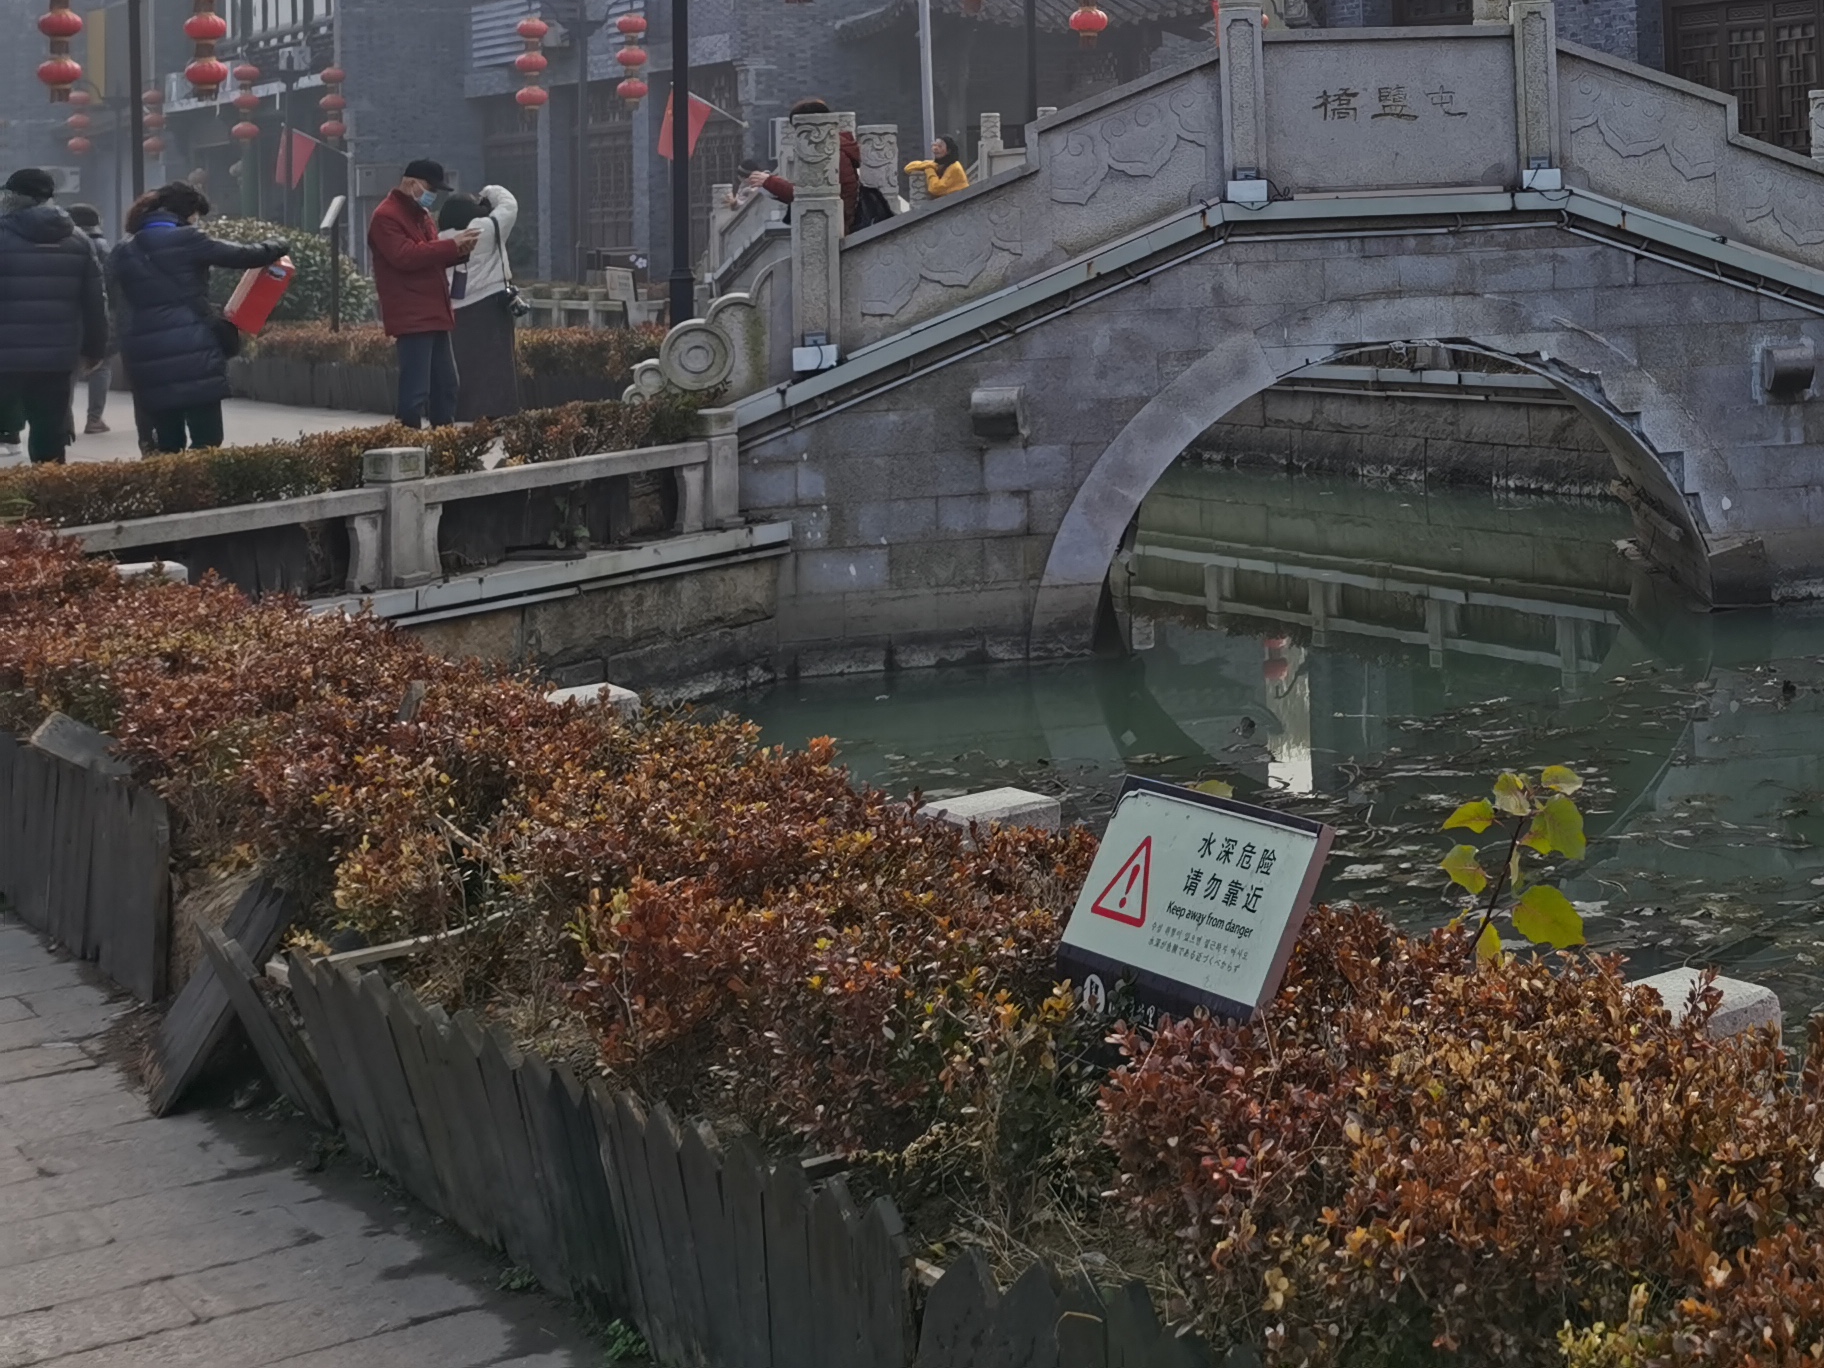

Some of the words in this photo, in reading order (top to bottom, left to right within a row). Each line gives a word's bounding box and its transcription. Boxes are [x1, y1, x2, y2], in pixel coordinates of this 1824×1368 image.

[1198, 832, 1276, 875] 水深危险
[1183, 867, 1263, 913] 请勿靠近
[1166, 900, 1186, 920] Keep
[1186, 909, 1207, 926] away
[1206, 912, 1225, 929] from
[1225, 919, 1254, 939] danger
